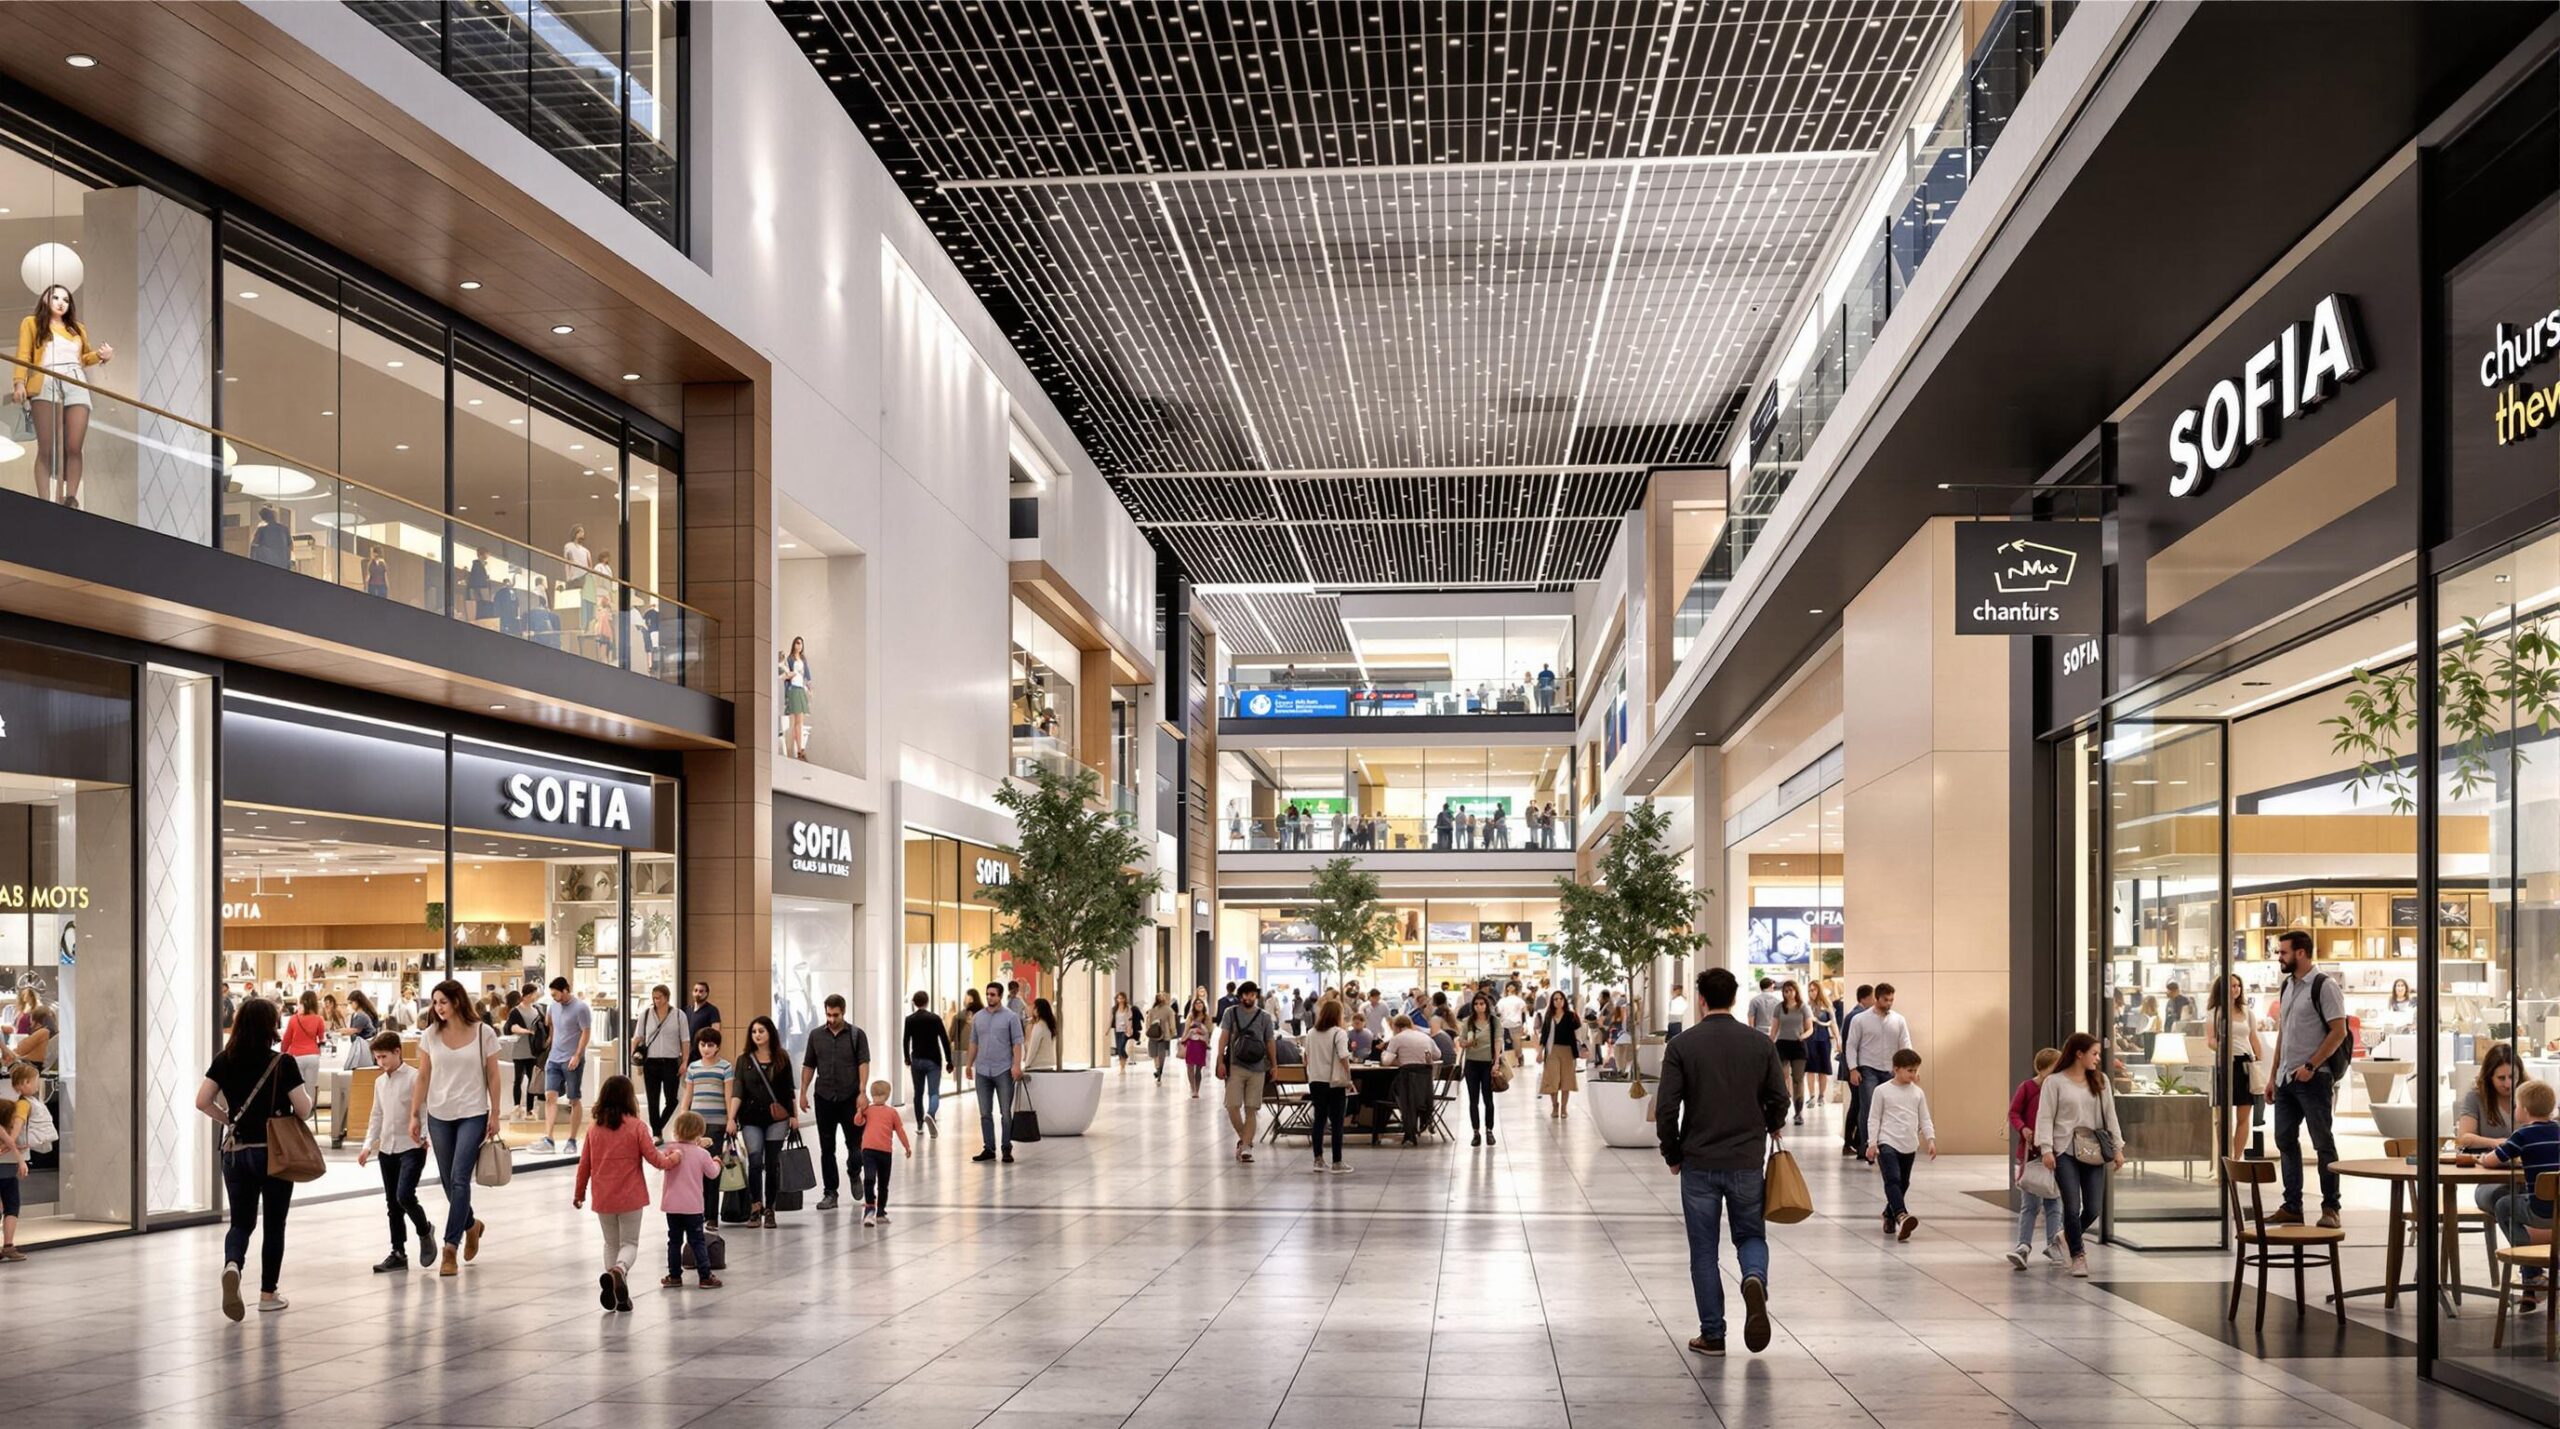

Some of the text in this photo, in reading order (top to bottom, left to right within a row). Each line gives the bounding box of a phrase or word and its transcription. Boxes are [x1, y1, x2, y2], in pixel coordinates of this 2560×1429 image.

[2168, 292, 2355, 498] SOFIA
[2063, 639, 2100, 676] SOFIA
[507, 773, 631, 830] SOFIA
[792, 820, 852, 863] SOFIA
[976, 857, 1010, 886] SOFIA
[31, 886, 89, 909] MOTS
